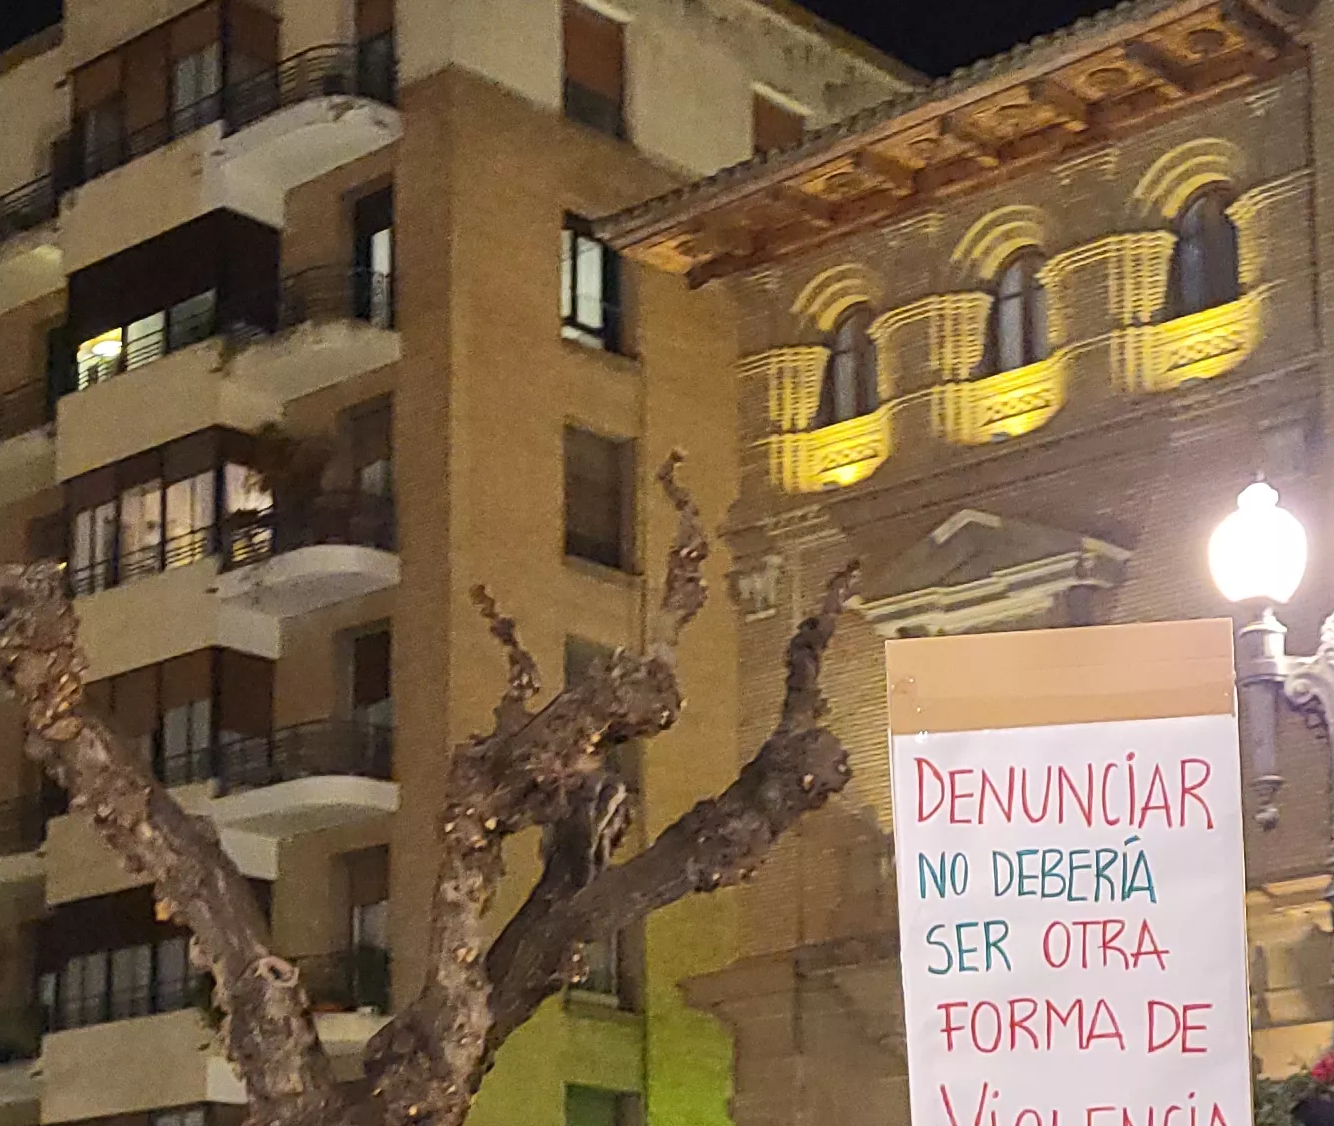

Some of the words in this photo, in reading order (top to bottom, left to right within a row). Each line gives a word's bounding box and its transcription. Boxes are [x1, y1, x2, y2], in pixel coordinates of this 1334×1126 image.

[919, 852, 968, 898] NO
[993, 836, 1156, 903] DEBERÍA
[927, 920, 1011, 974] SER
[1043, 919, 1169, 970] OTRA
[937, 998, 1125, 1053] FORMA
[1148, 1000, 1212, 1053] DE
